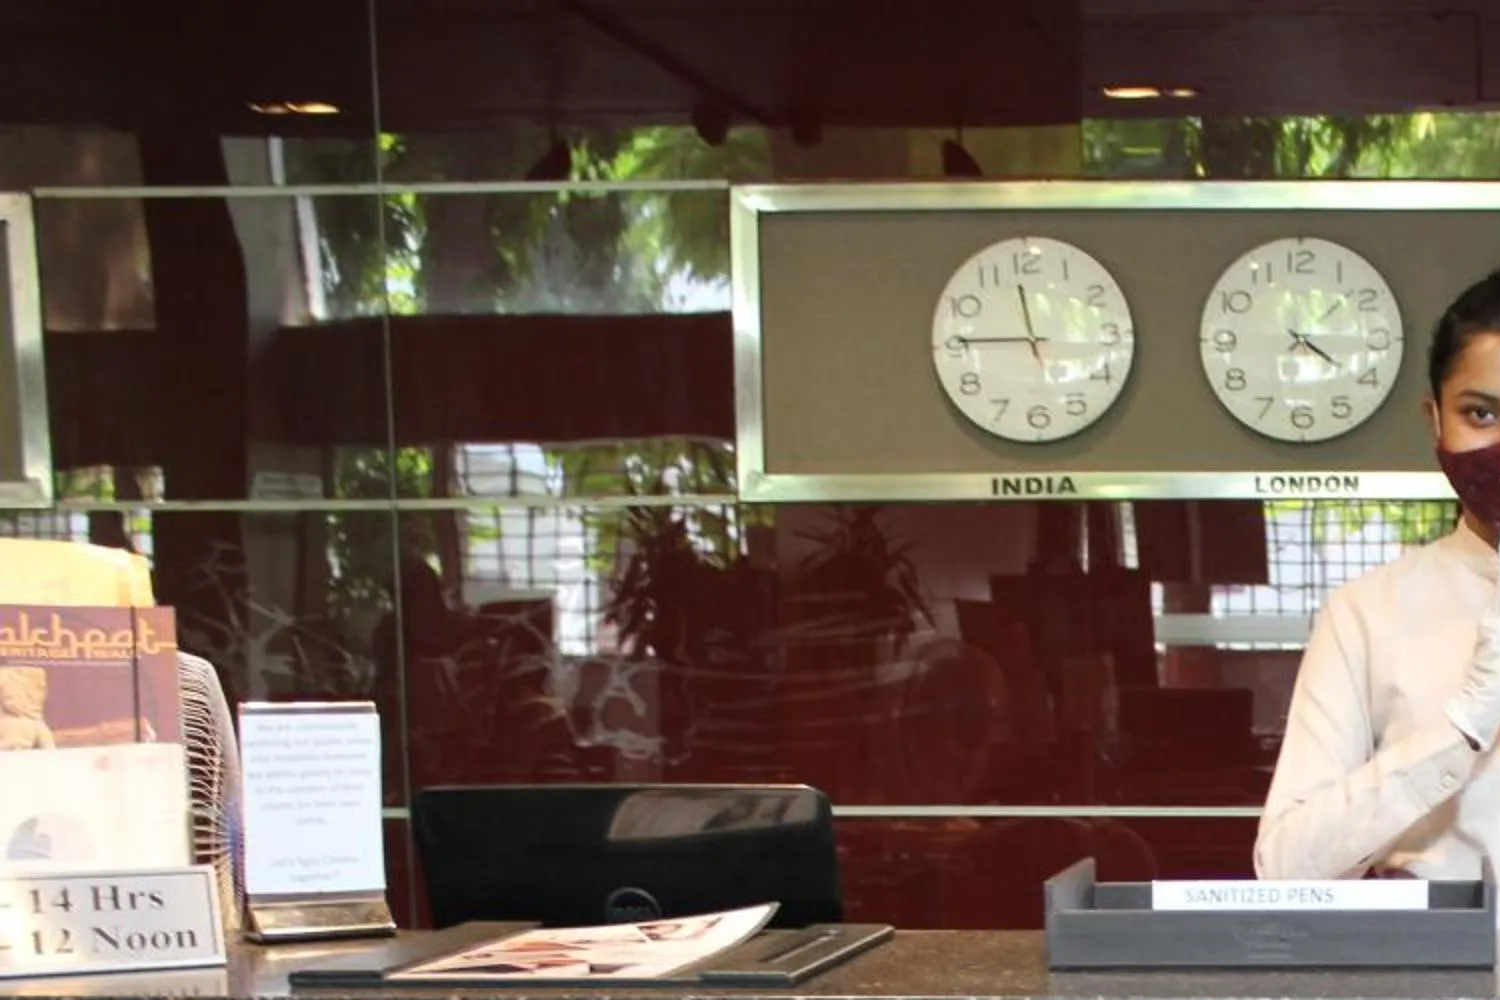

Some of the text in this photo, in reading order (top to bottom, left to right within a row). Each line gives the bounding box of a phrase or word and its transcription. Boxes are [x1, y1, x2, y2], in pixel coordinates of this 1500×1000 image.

[1012, 252, 1042, 274] 12
[1287, 251, 1316, 273] 12
[977, 265, 1001, 287] 11
[951, 296, 981, 317] 10
[1086, 285, 1105, 307] 2
[1221, 290, 1252, 313] 10
[1357, 289, 1379, 311] 2
[1099, 324, 1121, 344] 3
[1215, 329, 1238, 351] 9
[958, 373, 982, 394] 8
[1089, 363, 1112, 384] 4
[1224, 368, 1247, 391] 8
[1356, 368, 1379, 388] 4
[989, 399, 1011, 421] 7
[1027, 405, 1051, 428] 6
[1253, 397, 1276, 418] 7
[1290, 406, 1315, 429] 6
[1330, 396, 1352, 417] 5
[992, 477, 1078, 496] INDIA
[1255, 476, 1360, 494] LONDON
[29, 884, 165, 914] 14 Hrs
[1184, 887, 1334, 904] SANITIZED PENS
[31, 926, 199, 955] 12 Noon
